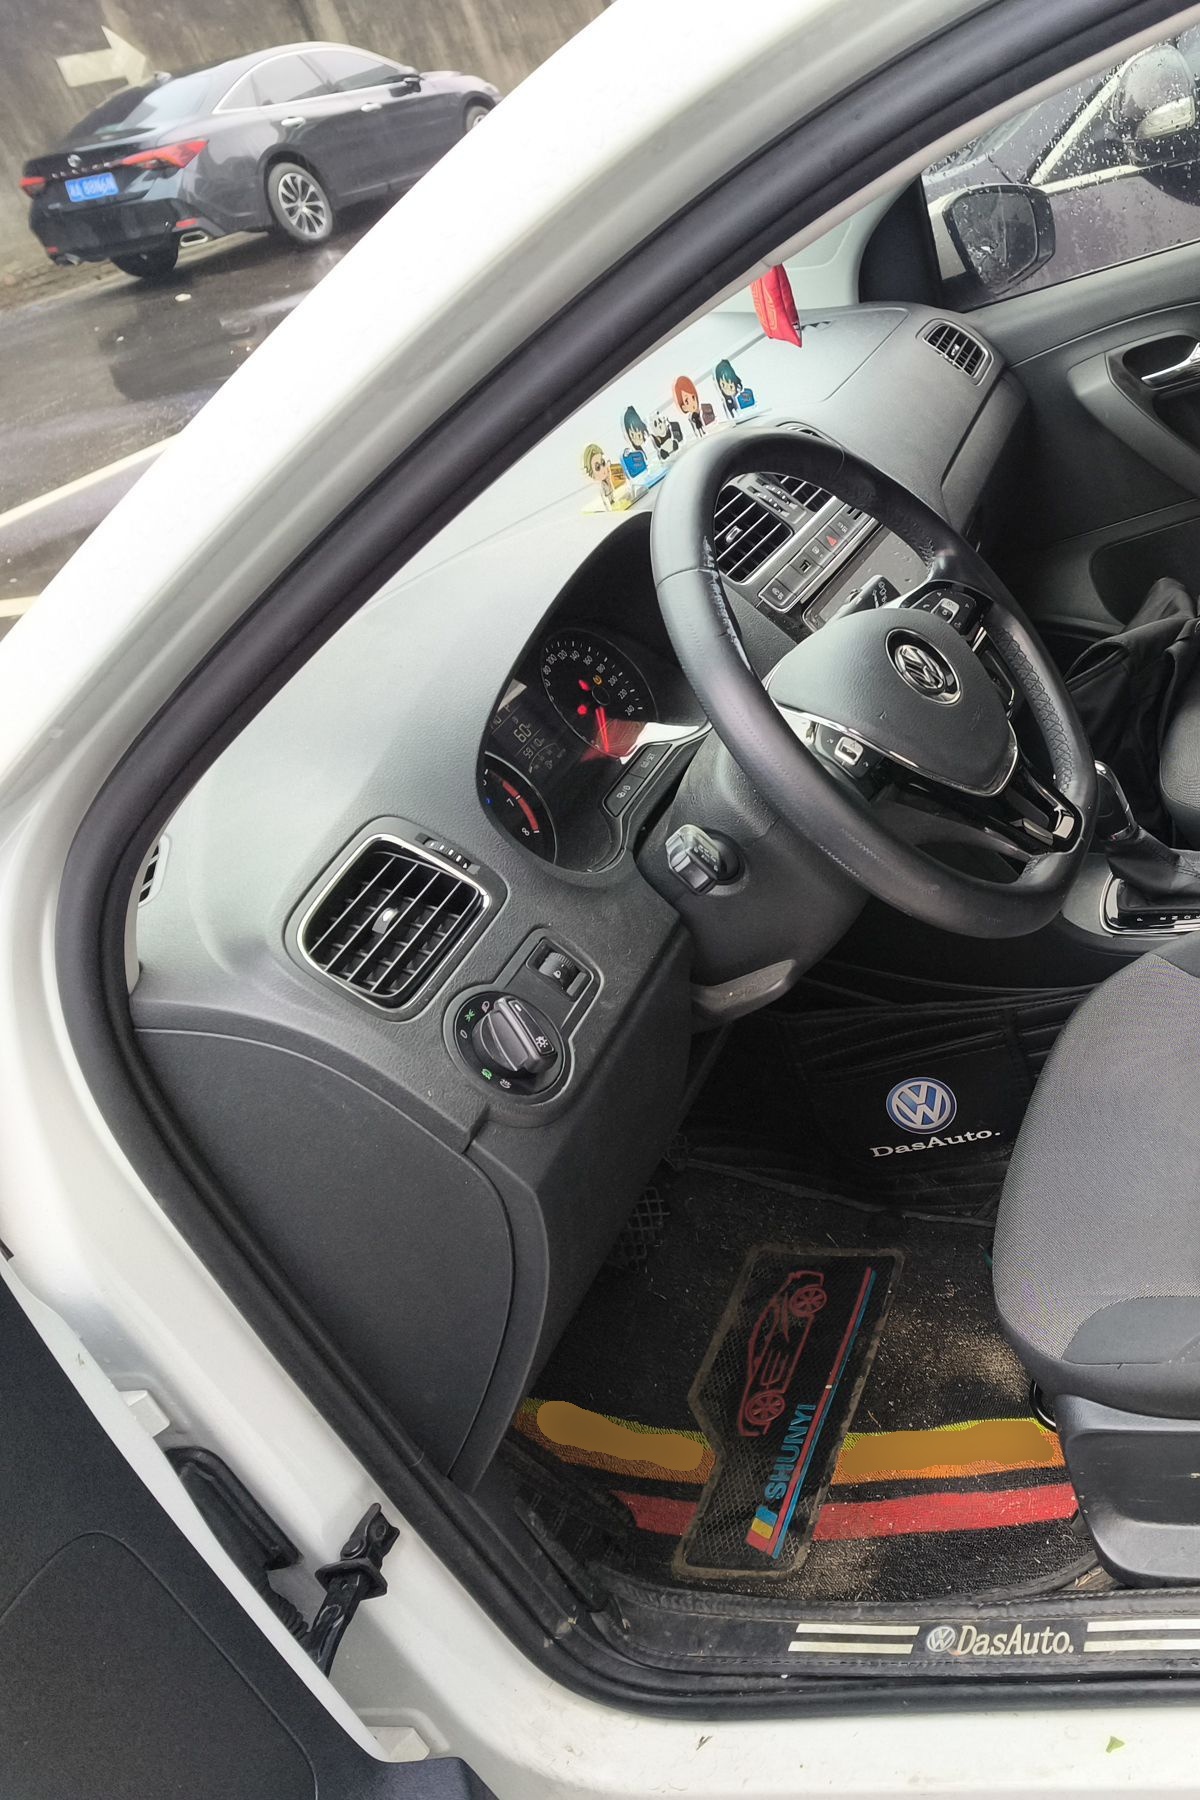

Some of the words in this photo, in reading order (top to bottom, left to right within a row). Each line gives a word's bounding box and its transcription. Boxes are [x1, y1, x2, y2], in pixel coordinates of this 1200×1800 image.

[546, 653, 558, 665] 100
[557, 649, 568, 661] 120
[569, 650, 580, 661] 140
[583, 655, 593, 666] 160
[596, 663, 606, 674] 180
[608, 675, 618, 687] 200
[618, 688, 628, 700] 220
[625, 705, 635, 716] 240
[513, 723, 532, 743] 60
[506, 797, 515, 807] 7
[521, 827, 530, 836] 8
[869, 1130, 1002, 1159] DasAuto.
[764, 1404, 817, 1500] SHUNYI
[956, 1623, 1075, 1656] DasAuto.
